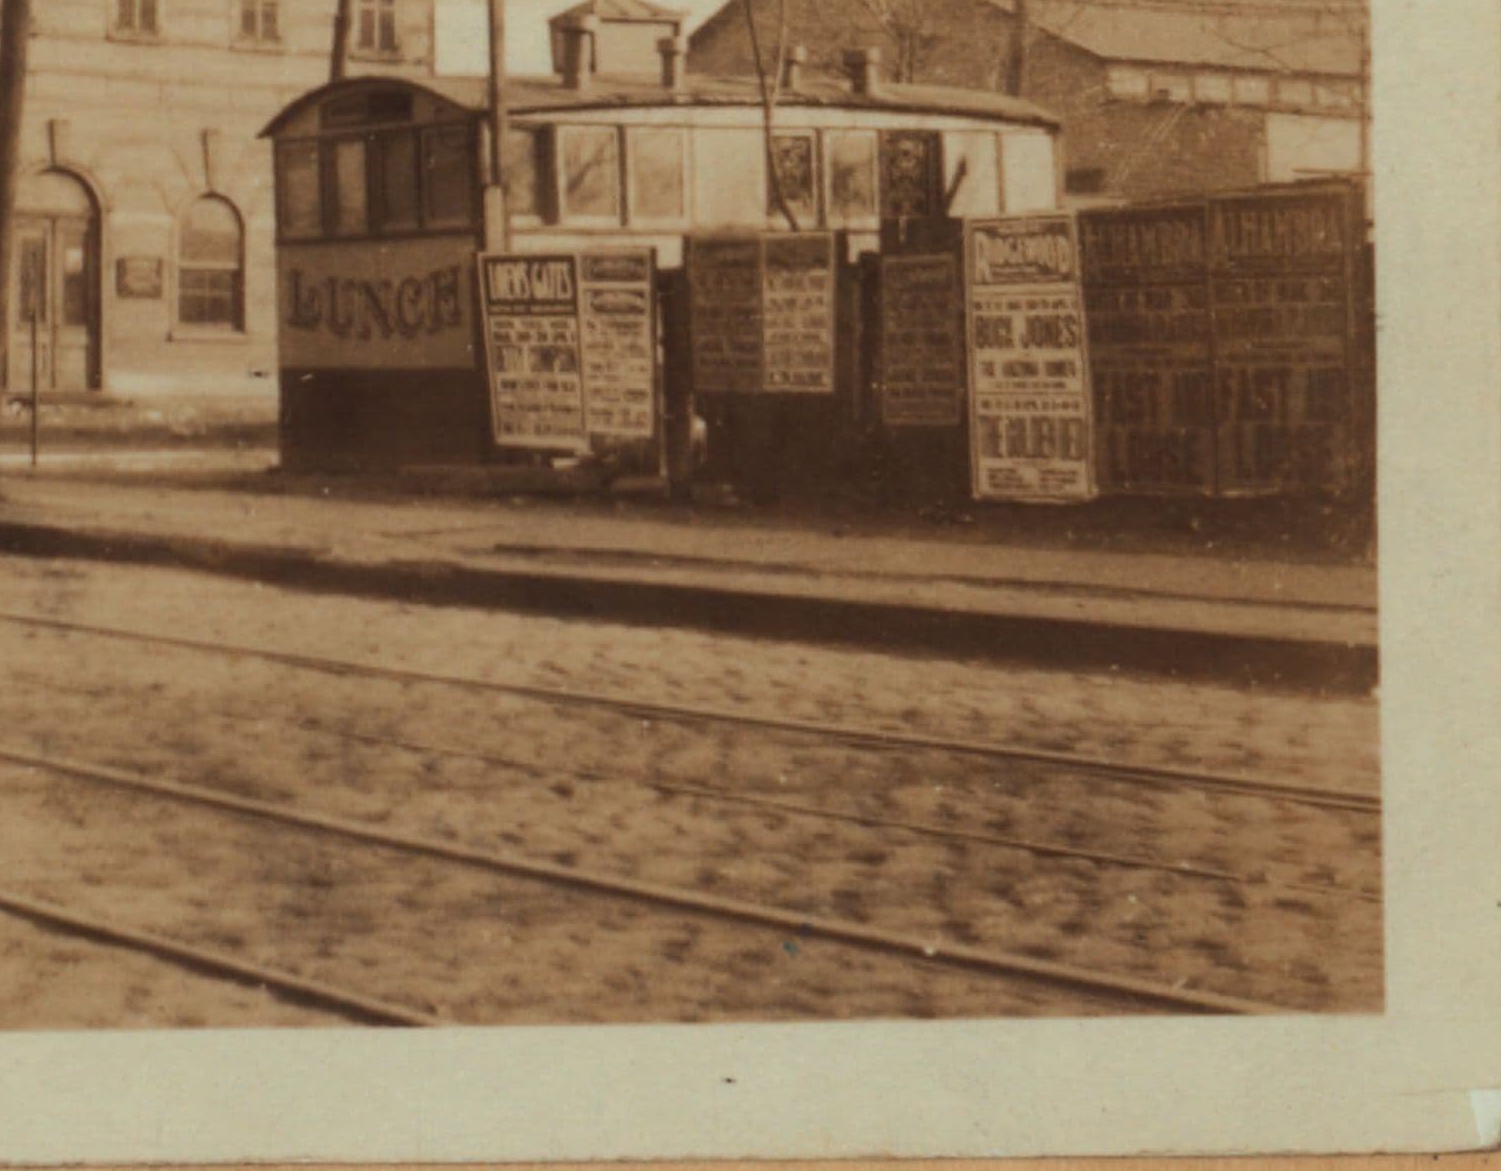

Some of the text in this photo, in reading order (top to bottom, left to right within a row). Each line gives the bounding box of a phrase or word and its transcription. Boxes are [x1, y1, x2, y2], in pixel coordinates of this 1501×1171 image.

[287, 263, 463, 341] LUNCH
[974, 314, 1013, 349] BUCK
[1020, 314, 1078, 349] JONES
